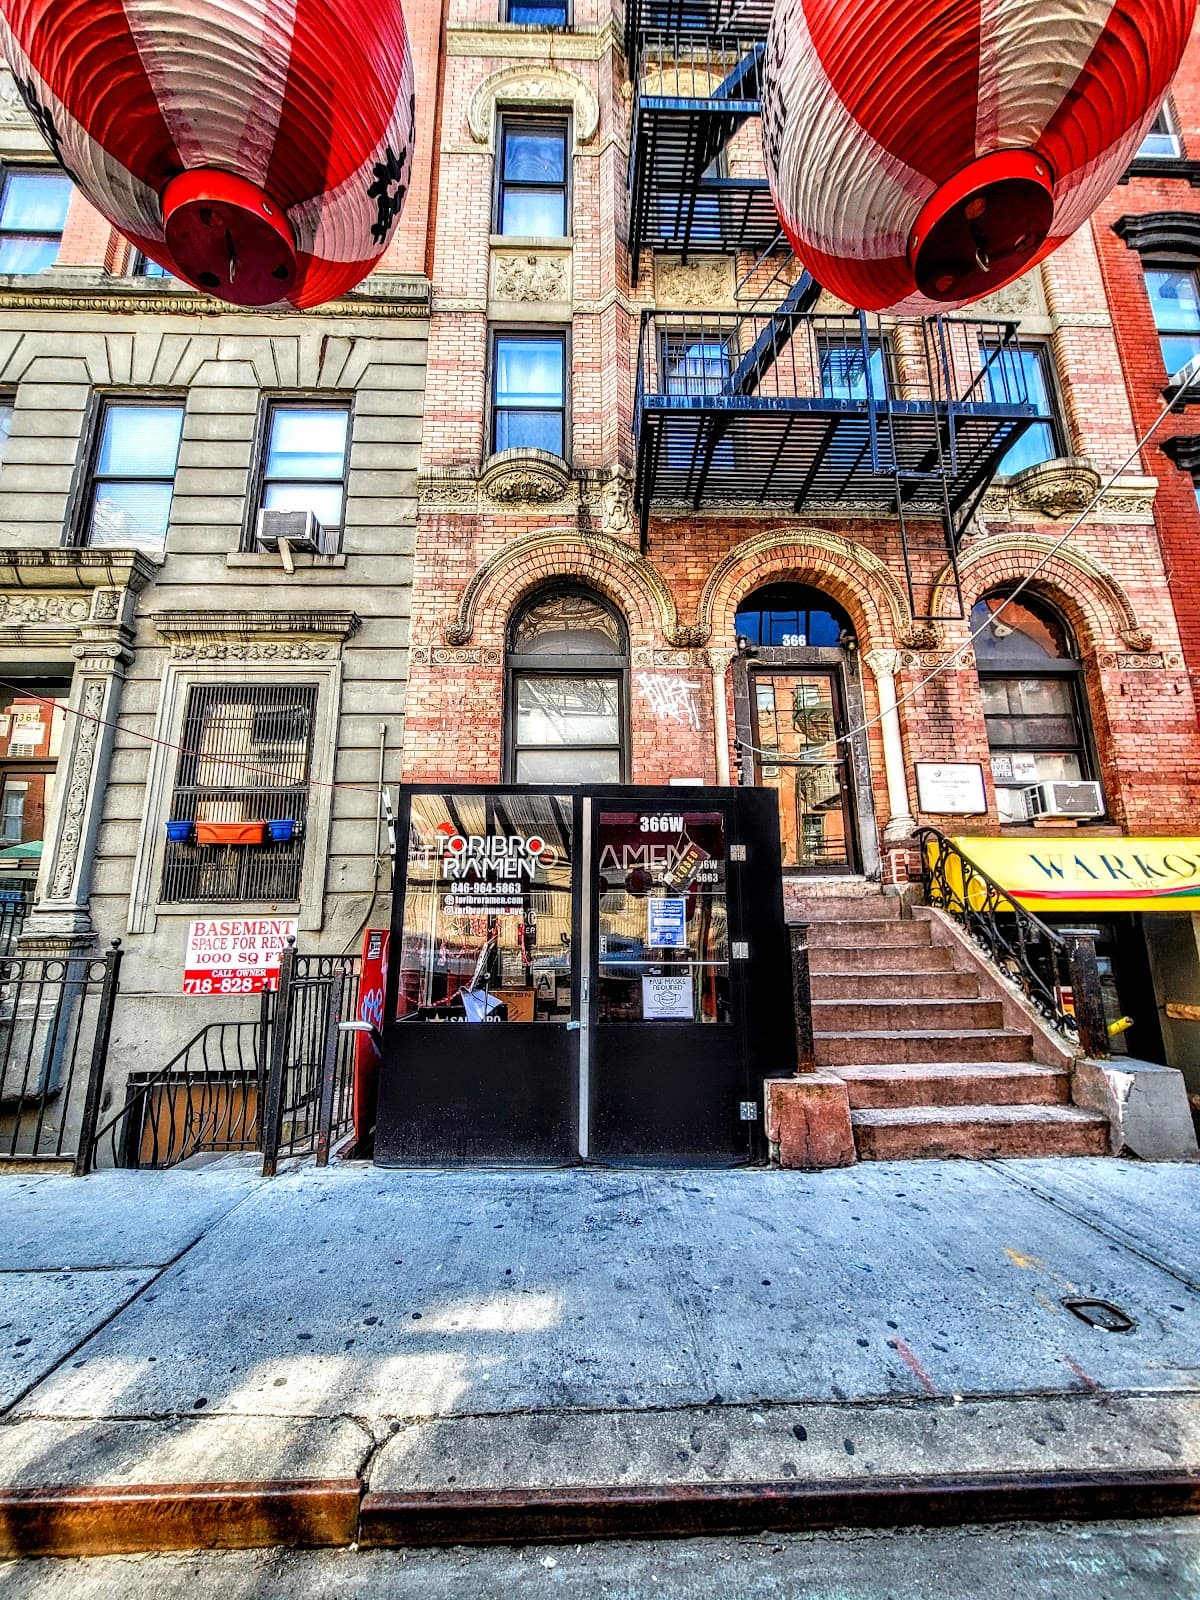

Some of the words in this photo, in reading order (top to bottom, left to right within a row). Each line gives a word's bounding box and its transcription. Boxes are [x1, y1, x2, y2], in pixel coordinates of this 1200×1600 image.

[782, 634, 806, 647] 366
[18, 713, 39, 722] 364
[639, 816, 684, 832] 366W
[435, 835, 545, 855] TORIBRO
[600, 844, 689, 869] AMEN
[442, 858, 536, 878] RAMEN
[673, 849, 699, 884] CLOSED
[450, 882, 521, 893] 646-964-5863
[1130, 880, 1160, 888] NYC
[454, 895, 524, 904] toribroramen.com
[193, 920, 294, 936] BASEMENT
[191, 937, 228, 950] SPACE
[232, 936, 256, 949] FOR
[261, 935, 286, 948] REN
[196, 952, 232, 963] 1000
[238, 952, 259, 965] SQ
[211, 969, 234, 977] CALL
[236, 969, 267, 977] OWNER
[184, 977, 279, 994] 718-828-11
[538, 973, 551, 991] A
